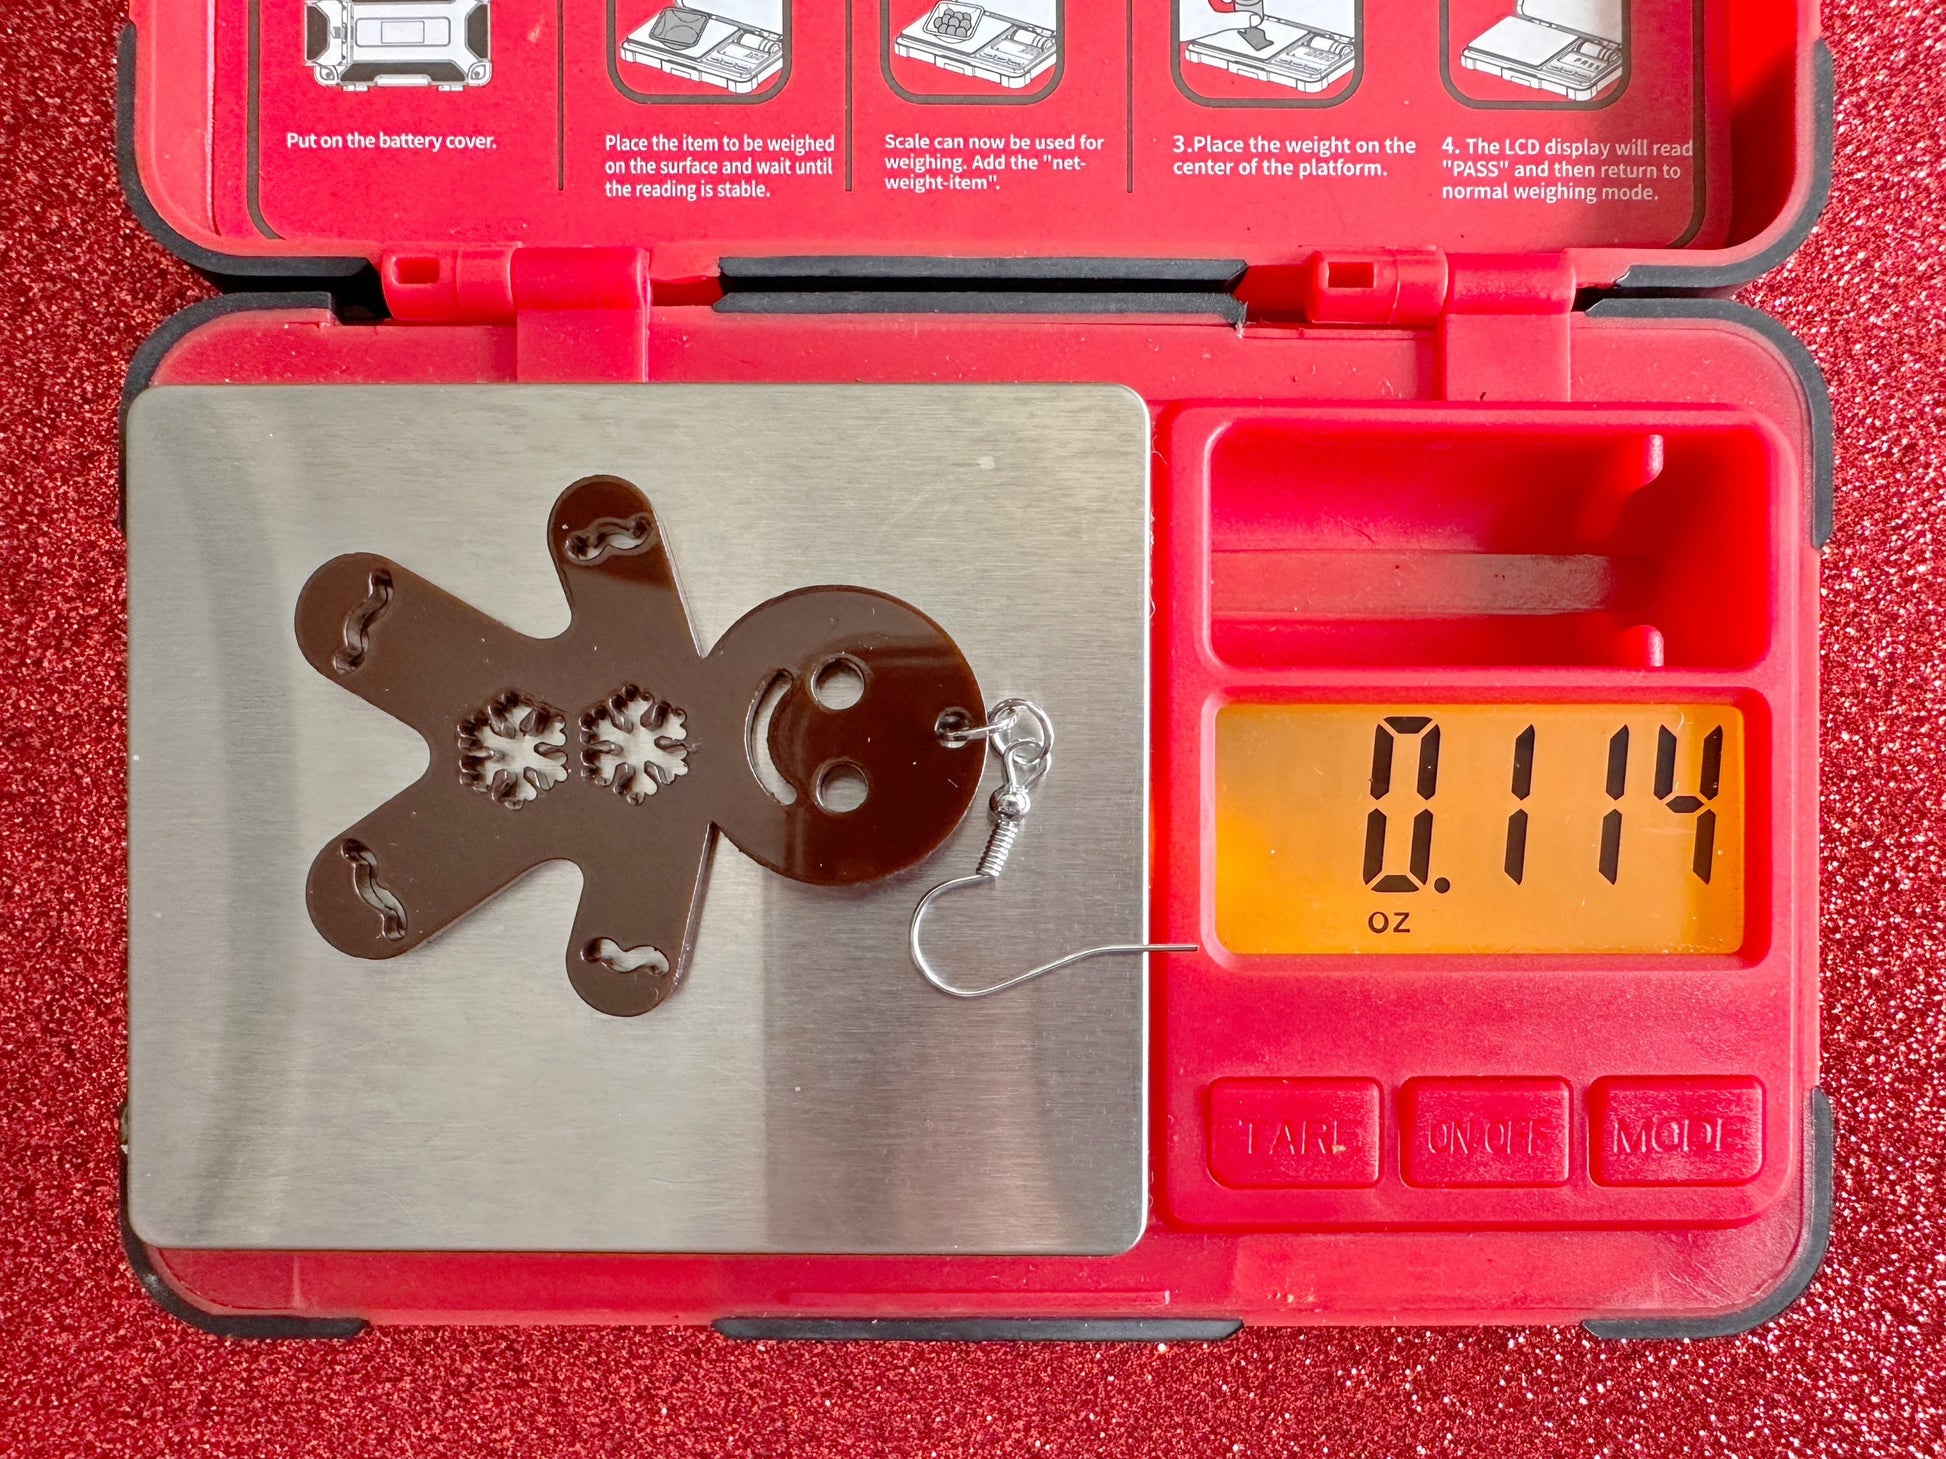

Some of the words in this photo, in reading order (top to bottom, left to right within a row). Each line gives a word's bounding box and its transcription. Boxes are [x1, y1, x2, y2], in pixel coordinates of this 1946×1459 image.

[286, 132, 318, 149] Put
[319, 135, 343, 149] on
[346, 131, 376, 149] the
[379, 131, 443, 153] battery
[445, 135, 497, 149] cover.
[605, 133, 649, 152] Place
[651, 133, 679, 152] the
[682, 133, 719, 152] item
[722, 135, 740, 152] to
[743, 133, 764, 152] be
[766, 133, 835, 156] weighed
[884, 132, 931, 149] Scale
[933, 136, 964, 150] can
[968, 136, 1006, 150] now
[1009, 133, 1031, 150] be
[1034, 133, 1076, 151] used
[1079, 133, 1105, 151] for
[1172, 134, 1245, 154] 3.Place
[1248, 135, 1281, 154] the
[1285, 135, 1352, 159] weight
[1354, 140, 1380, 155] on
[1383, 135, 1417, 155] the
[1441, 137, 1460, 155] 4.
[1465, 137, 1500, 155] The
[1505, 138, 1540, 155] LCD
[1544, 137, 1611, 160] display
[1615, 138, 1648, 156] will
[1652, 139, 1693, 157] read
[604, 160, 626, 175] on
[629, 156, 657, 175] the
[659, 156, 719, 175] surface
[721, 156, 753, 175] and
[755, 156, 792, 175] wait
[795, 155, 833, 175] until
[884, 152, 968, 174] weighing.
[971, 153, 1006, 171] Add
[1009, 153, 1039, 171] the
[1042, 154, 1087, 171] "net-
[1172, 158, 1235, 176] center
[1238, 157, 1259, 176] of
[1261, 157, 1294, 177] the
[1298, 156, 1388, 181] platform.
[1442, 159, 1509, 178] "PASS"
[1514, 160, 1549, 177] and
[1554, 160, 1595, 178] then
[1601, 163, 1657, 179] return
[1662, 164, 1681, 179] to
[604, 179, 632, 198] the
[635, 179, 698, 202] reading
[700, 179, 714, 198] is
[717, 179, 771, 198] stable.
[884, 173, 1001, 194] weight-item".
[1442, 182, 1509, 199] normal
[1513, 182, 1597, 204] weighing
[1602, 183, 1659, 201] mode.
[1362, 716, 1723, 894] 0.114
